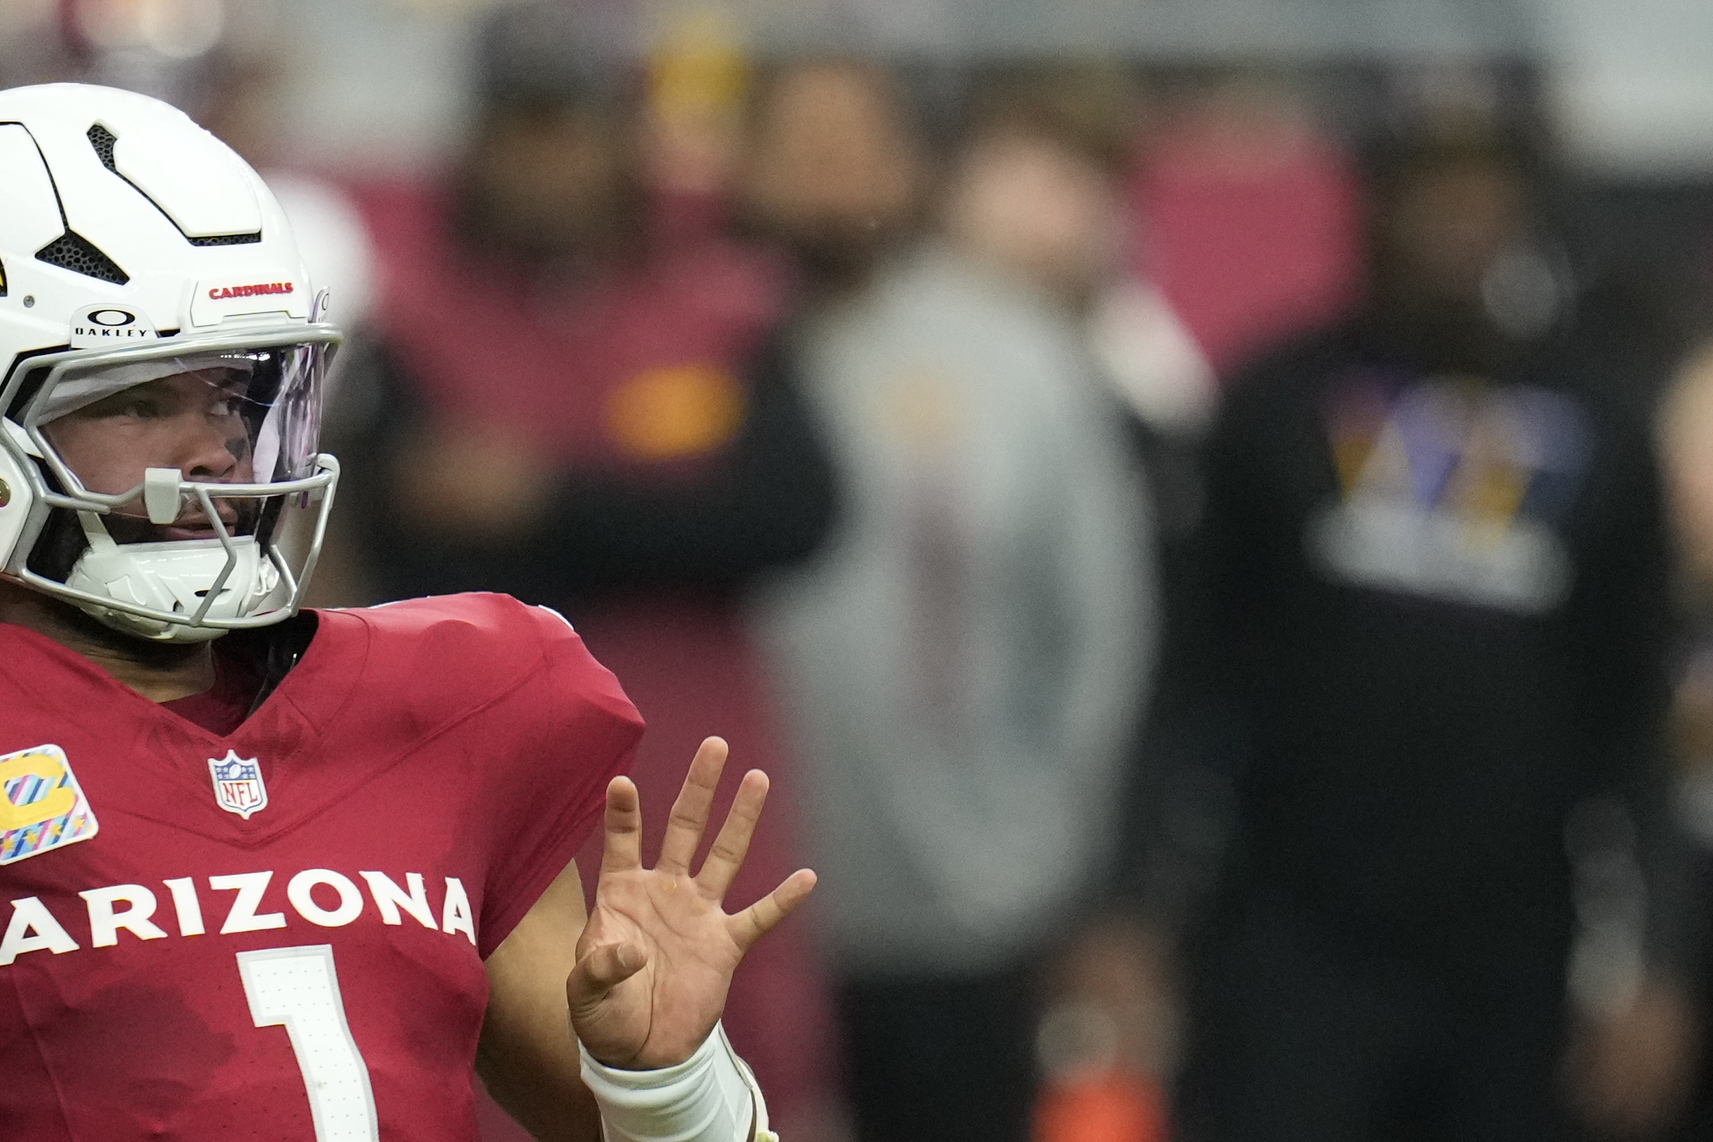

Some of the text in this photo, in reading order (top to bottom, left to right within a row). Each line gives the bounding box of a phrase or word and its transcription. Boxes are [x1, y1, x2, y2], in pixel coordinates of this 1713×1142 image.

[208, 282, 294, 300] CARDINALS
[75, 327, 149, 338] OAKLEY
[222, 782, 259, 807] NFL
